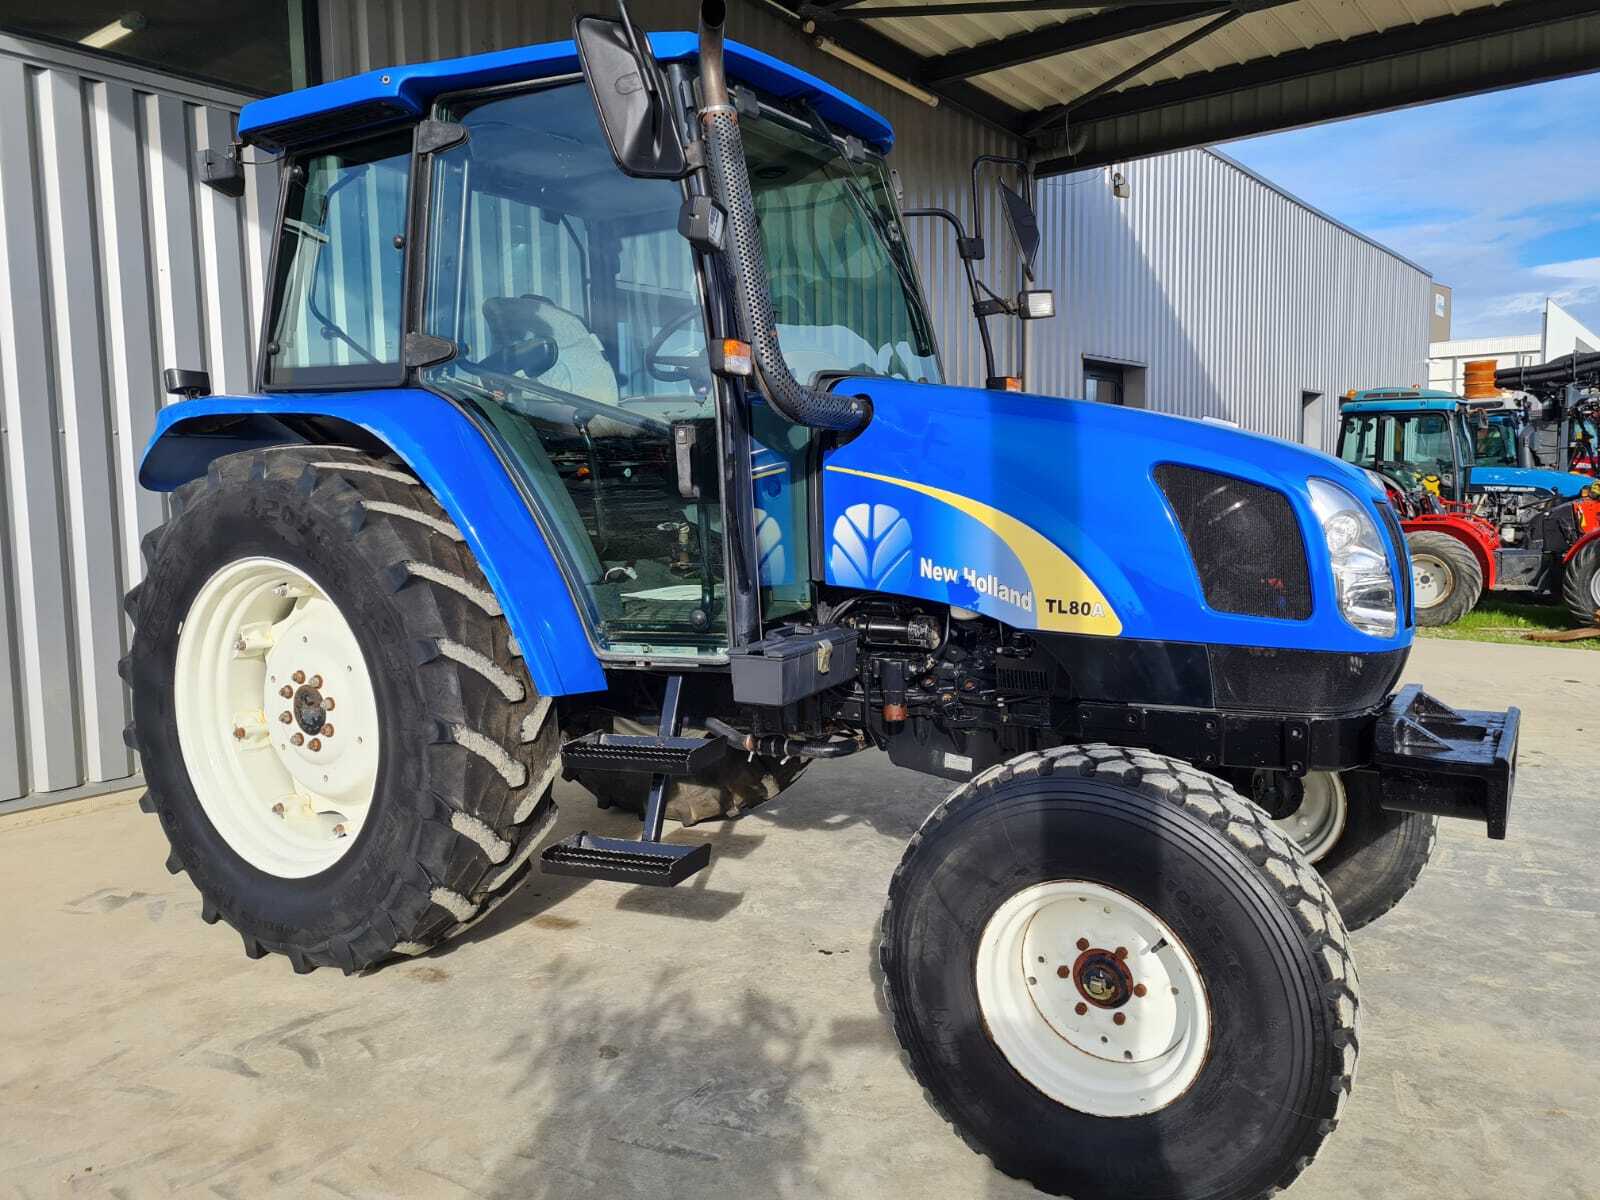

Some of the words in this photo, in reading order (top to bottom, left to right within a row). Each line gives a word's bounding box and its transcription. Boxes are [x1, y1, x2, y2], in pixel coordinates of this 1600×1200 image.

[920, 557, 958, 584] New
[963, 567, 1032, 612] Holland
[1046, 598, 1105, 617] TL80A
